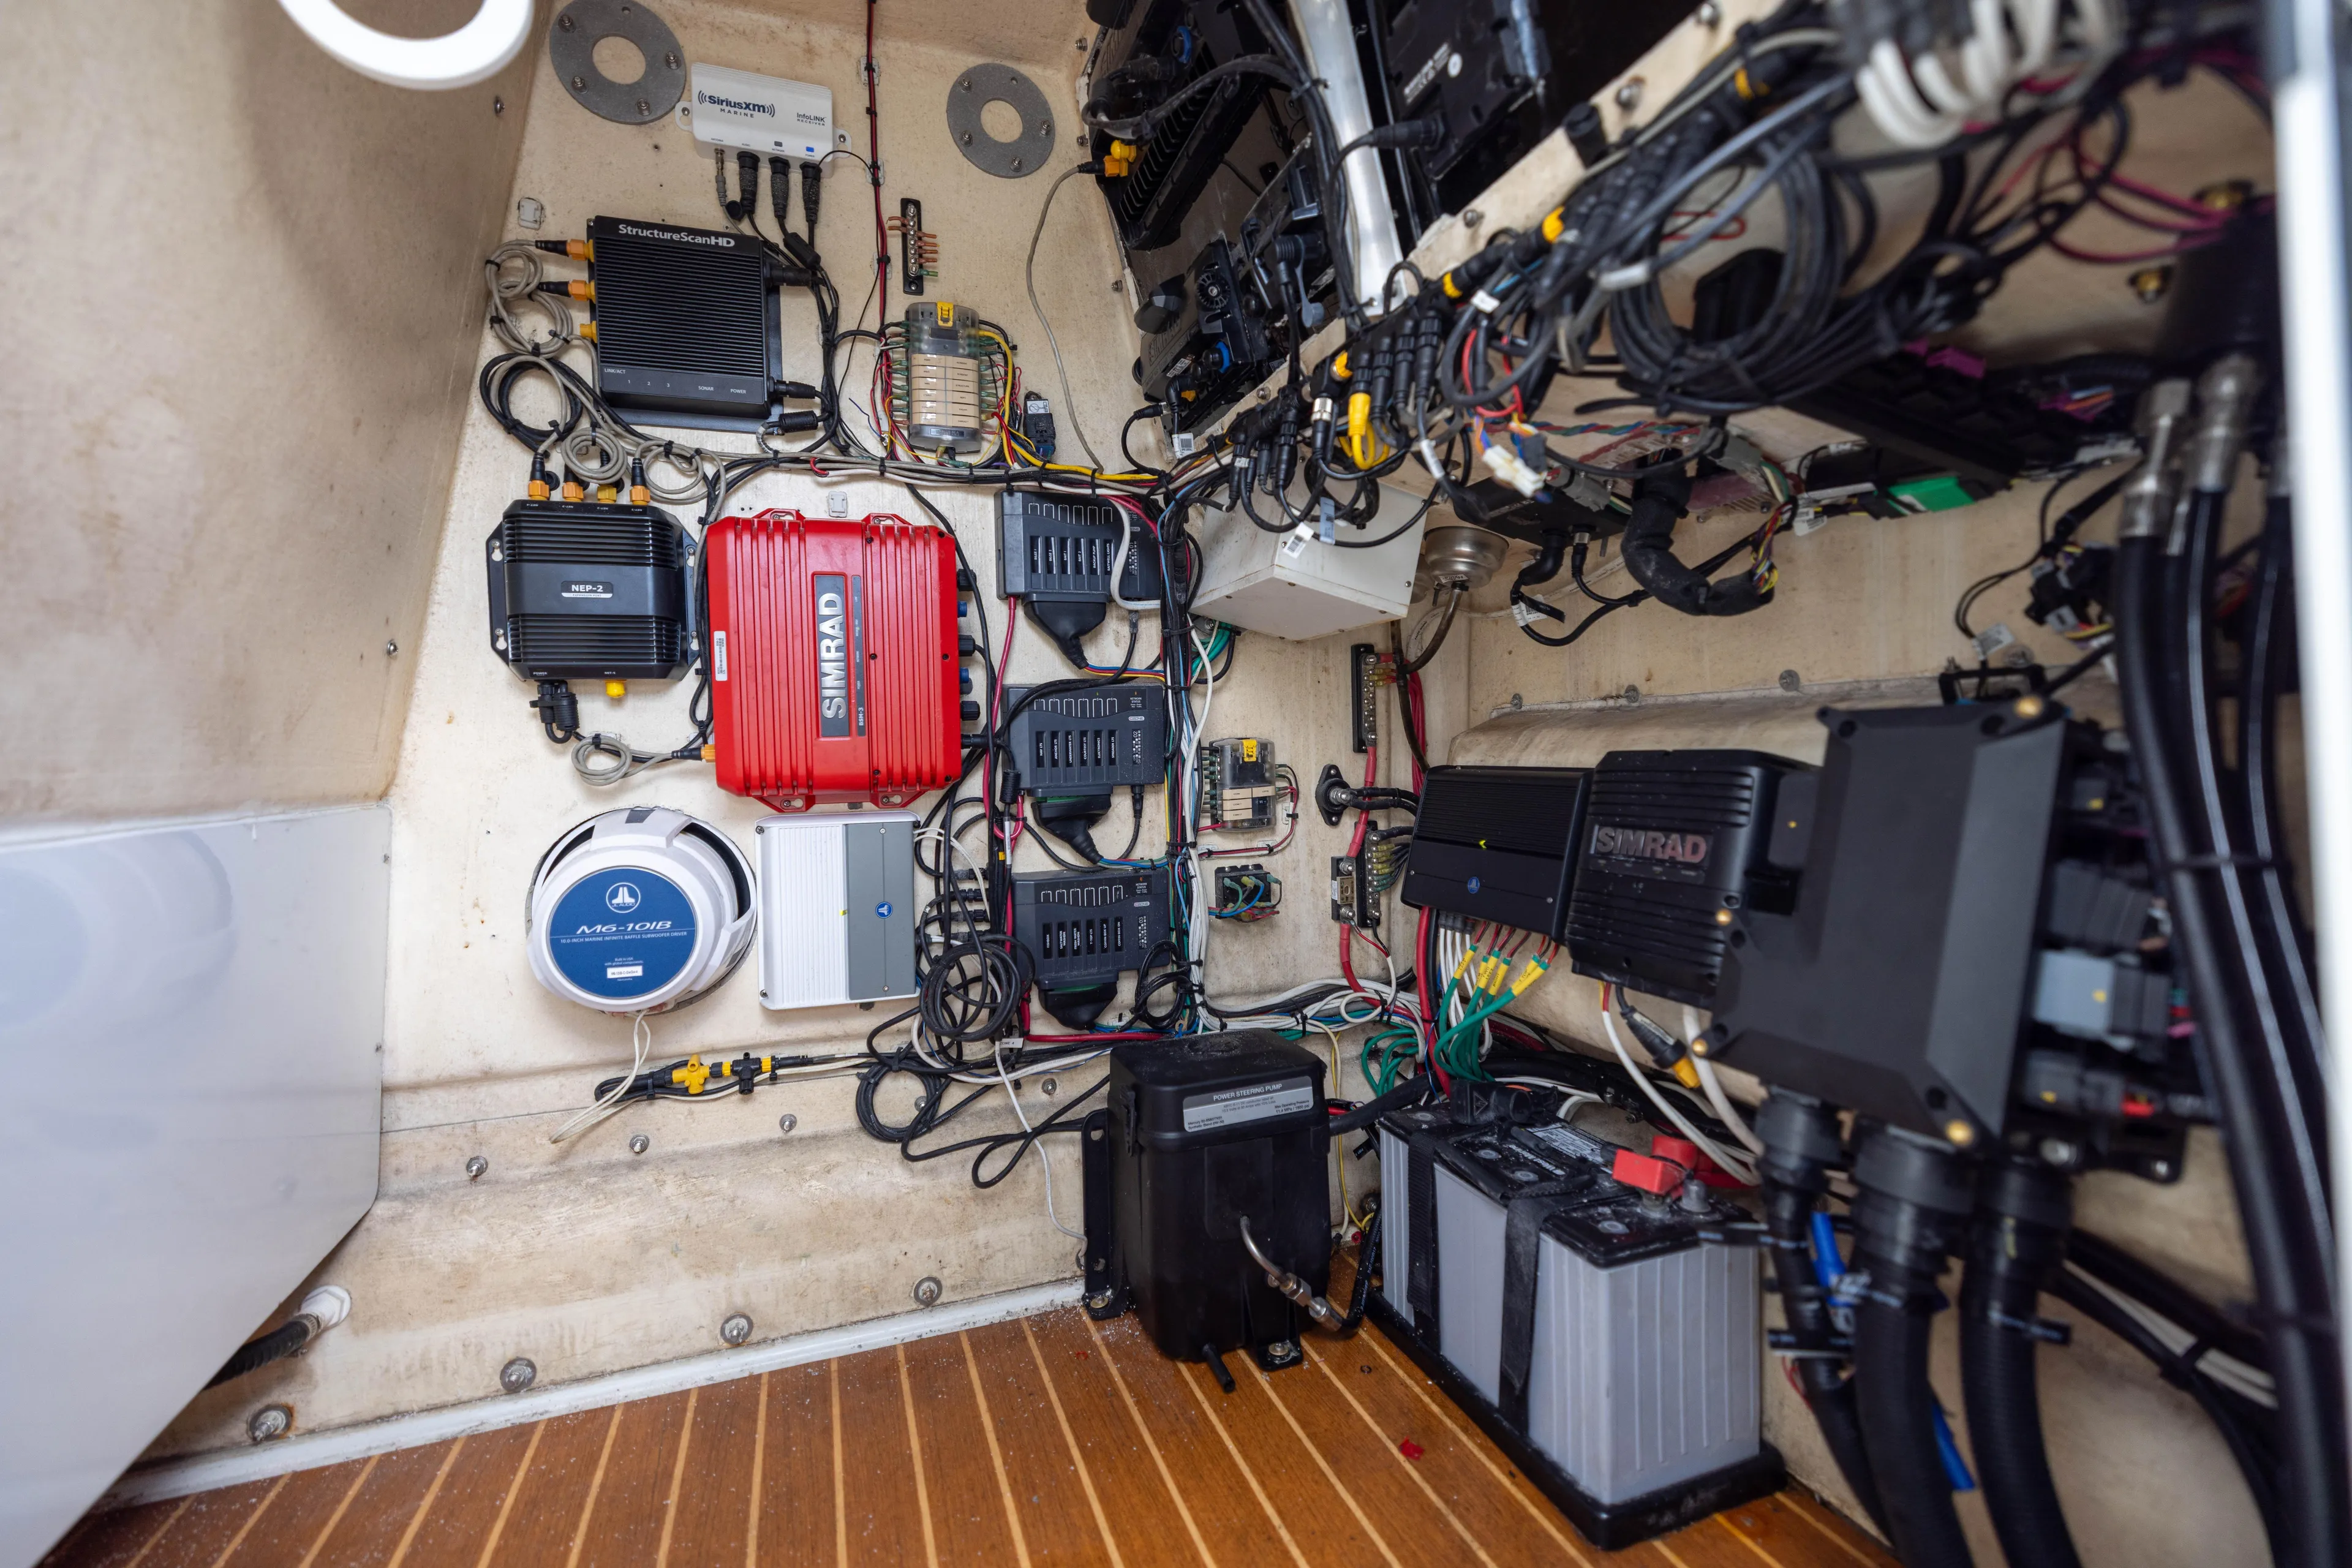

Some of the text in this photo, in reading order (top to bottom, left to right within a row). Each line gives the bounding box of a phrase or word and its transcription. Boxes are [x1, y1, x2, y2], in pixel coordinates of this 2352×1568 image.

[720, 108, 754, 118] MARINE
[797, 113, 825, 123] InfoLINK
[619, 224, 735, 247] StructureScanHD
[818, 593, 847, 719] SIMRAD
[1596, 827, 1707, 864] SIMRAD
[1213, 1092, 1235, 1101] POWER
[1236, 1087, 1265, 1097] STEERING
